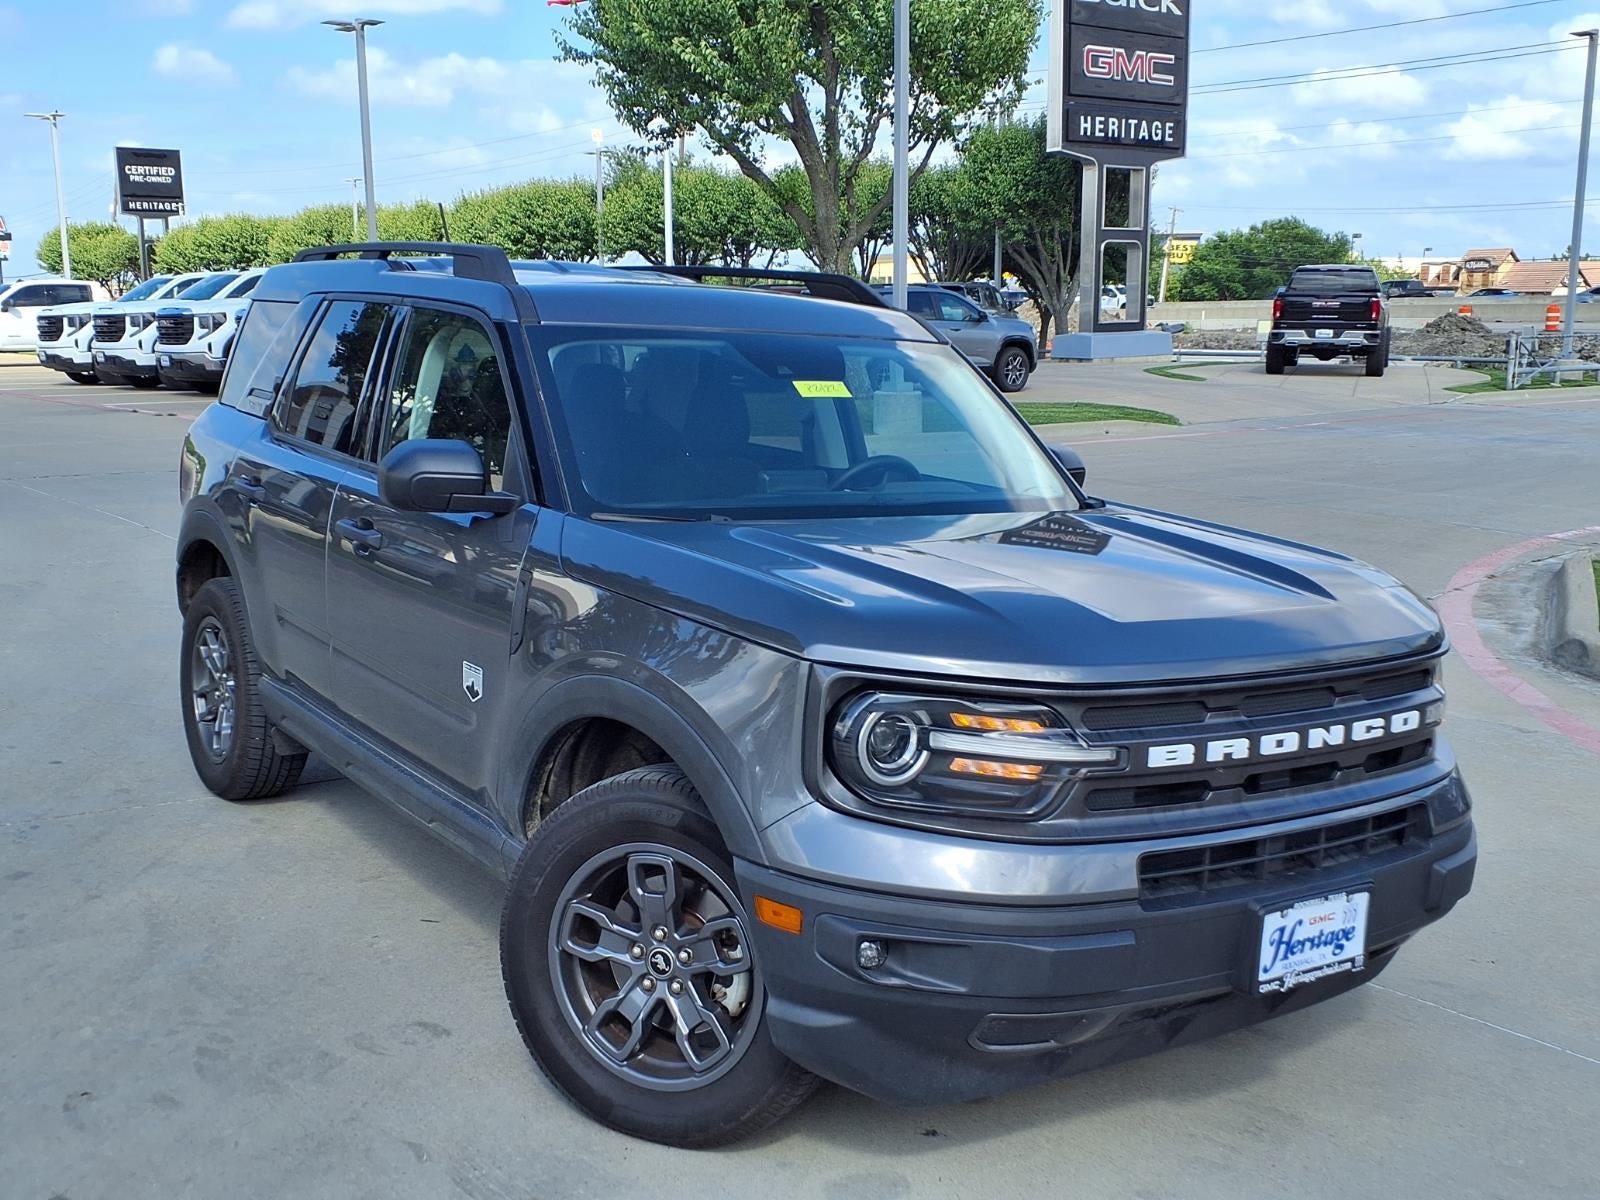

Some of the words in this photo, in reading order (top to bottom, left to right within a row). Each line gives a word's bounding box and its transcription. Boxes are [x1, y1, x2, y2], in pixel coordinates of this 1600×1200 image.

[1083, 44, 1175, 86] GMC
[1080, 115, 1175, 142] HERITAGE
[124, 165, 176, 176] CERTIFIED
[129, 175, 172, 183] PRE-OWNED
[128, 201, 178, 211] HERITAGE
[1147, 709, 1420, 768] BRONCO
[1308, 911, 1336, 926] GMC
[1262, 918, 1356, 974] Heritage
